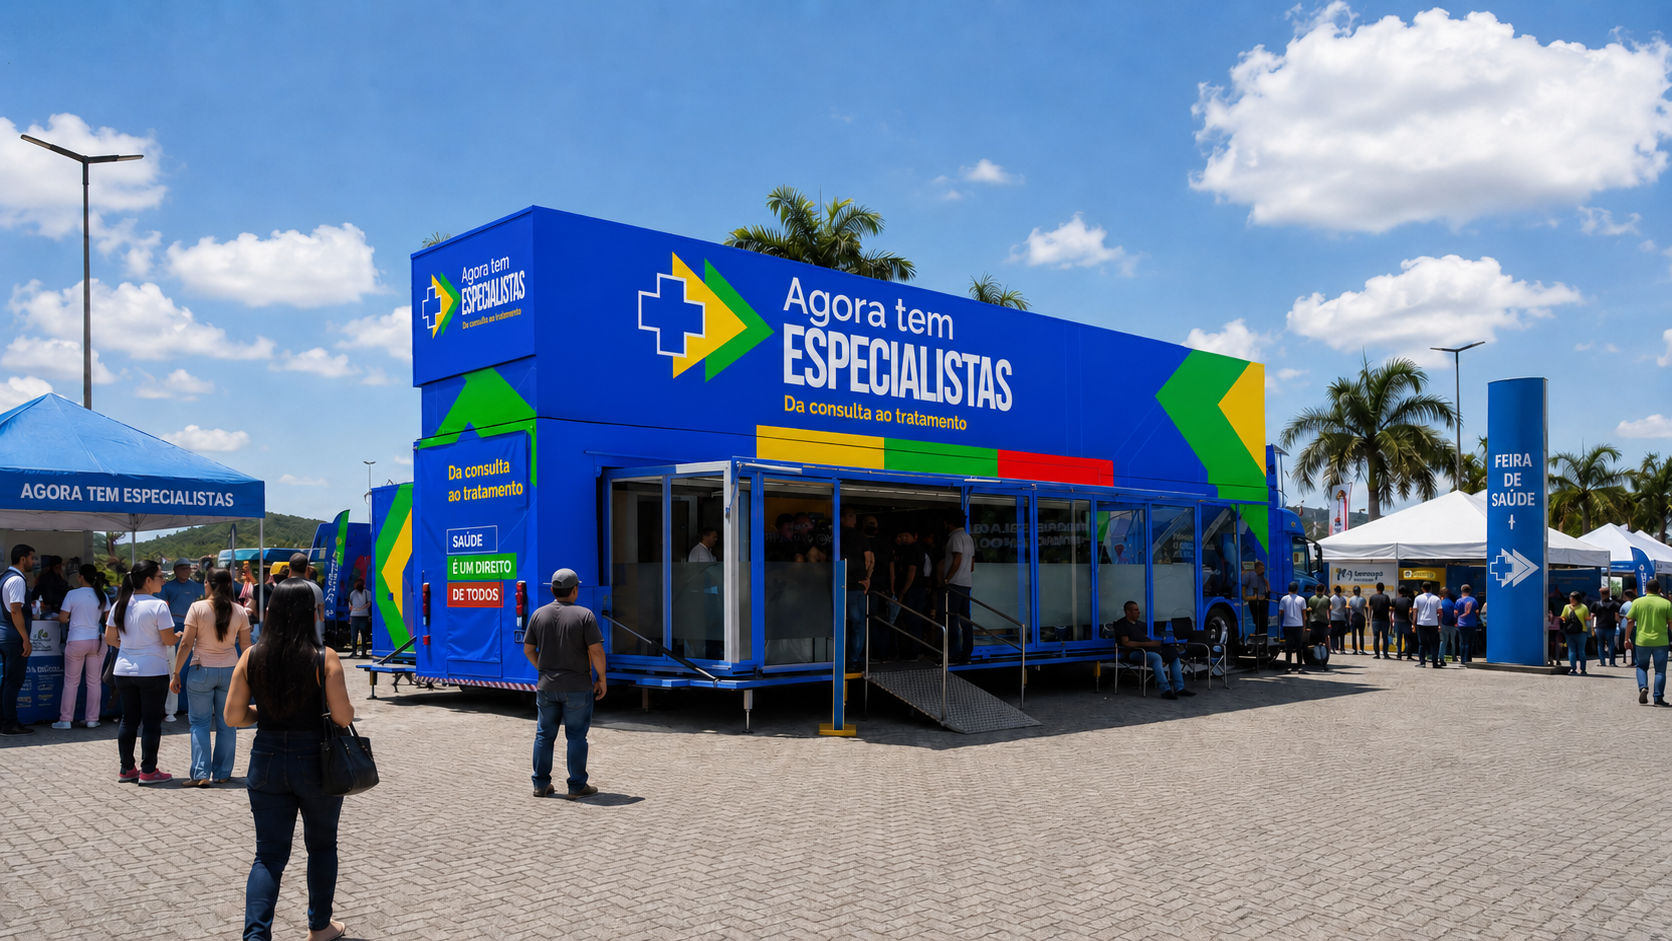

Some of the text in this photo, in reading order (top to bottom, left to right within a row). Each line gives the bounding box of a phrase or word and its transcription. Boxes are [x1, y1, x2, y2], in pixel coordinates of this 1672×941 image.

[461, 256, 510, 285] Agora tem
[461, 270, 525, 316] ESPECIALISTAS
[783, 276, 953, 340] Agora tem
[783, 323, 1012, 412] ESPECIALISTAS
[785, 395, 966, 430] Da consulta ao tratamento
[449, 459, 509, 480] Da consulta
[1495, 453, 1532, 467] FEIRA
[1504, 473, 1521, 487] DE
[21, 483, 233, 506] AGORA TEM ESPECIALISTAS
[449, 481, 523, 502] ao tratamento
[1492, 489, 1534, 506] SAÚDE
[452, 531, 483, 548] SAÚDE
[452, 559, 511, 574] É UM DIREITO
[453, 588, 499, 601] DE TODOS
